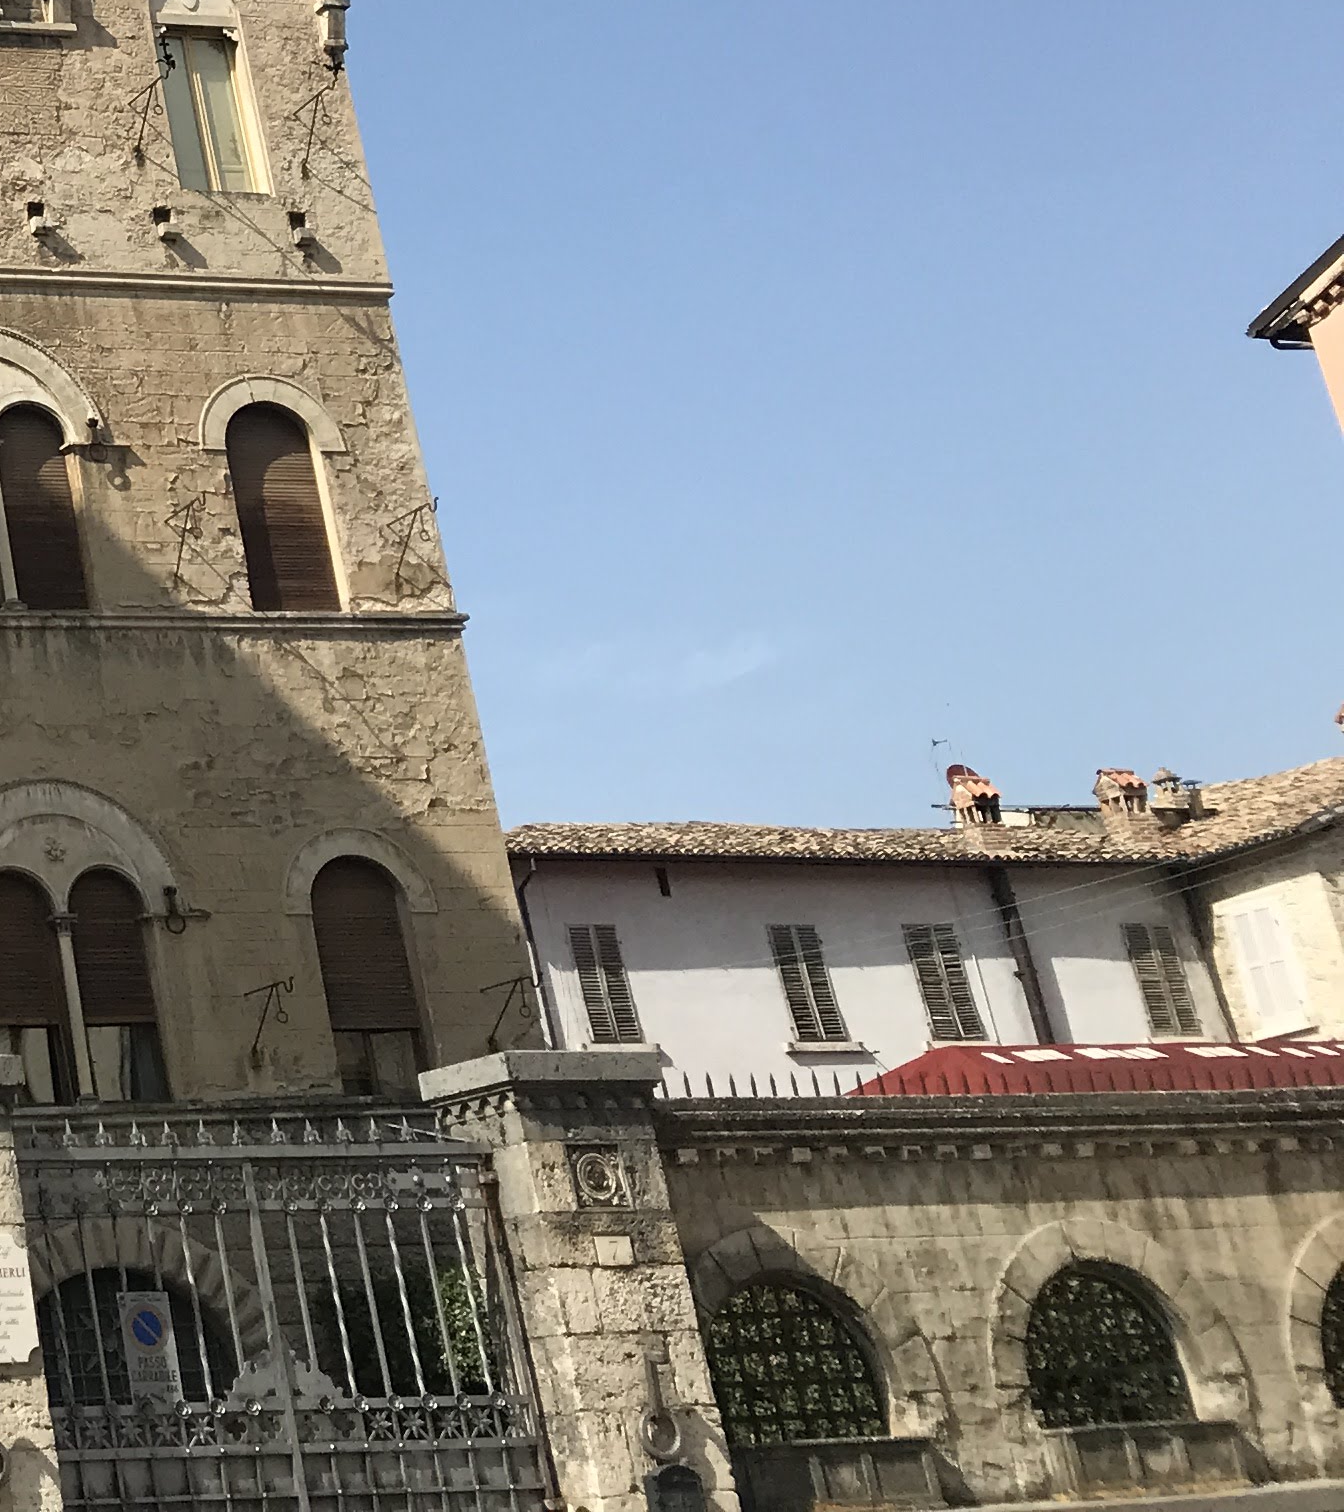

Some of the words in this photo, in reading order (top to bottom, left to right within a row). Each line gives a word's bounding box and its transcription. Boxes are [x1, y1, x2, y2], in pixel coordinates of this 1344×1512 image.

[609, 1240, 618, 1261] 7
[138, 1356, 167, 1368] PASSO
[133, 1369, 178, 1382] CARRABILE
